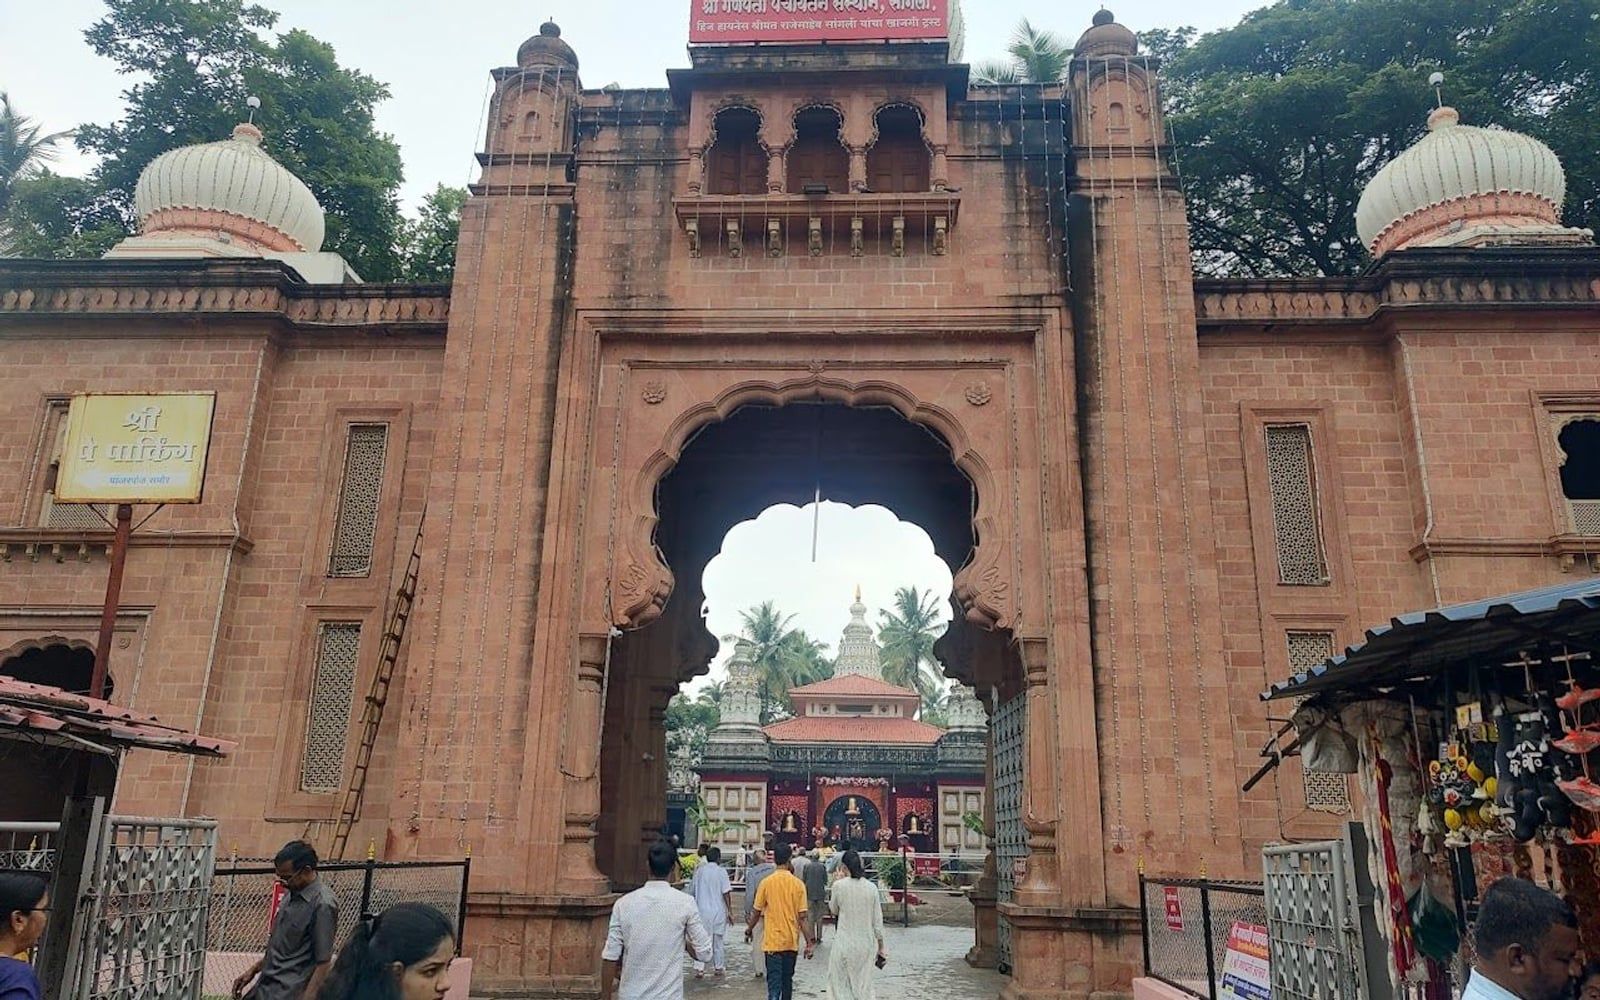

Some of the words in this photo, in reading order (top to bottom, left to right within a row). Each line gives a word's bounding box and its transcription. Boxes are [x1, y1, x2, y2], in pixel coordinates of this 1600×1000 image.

[826, 17, 857, 29] सांगली
[860, 17, 883, 29] यांचा
[121, 405, 163, 432] श्री
